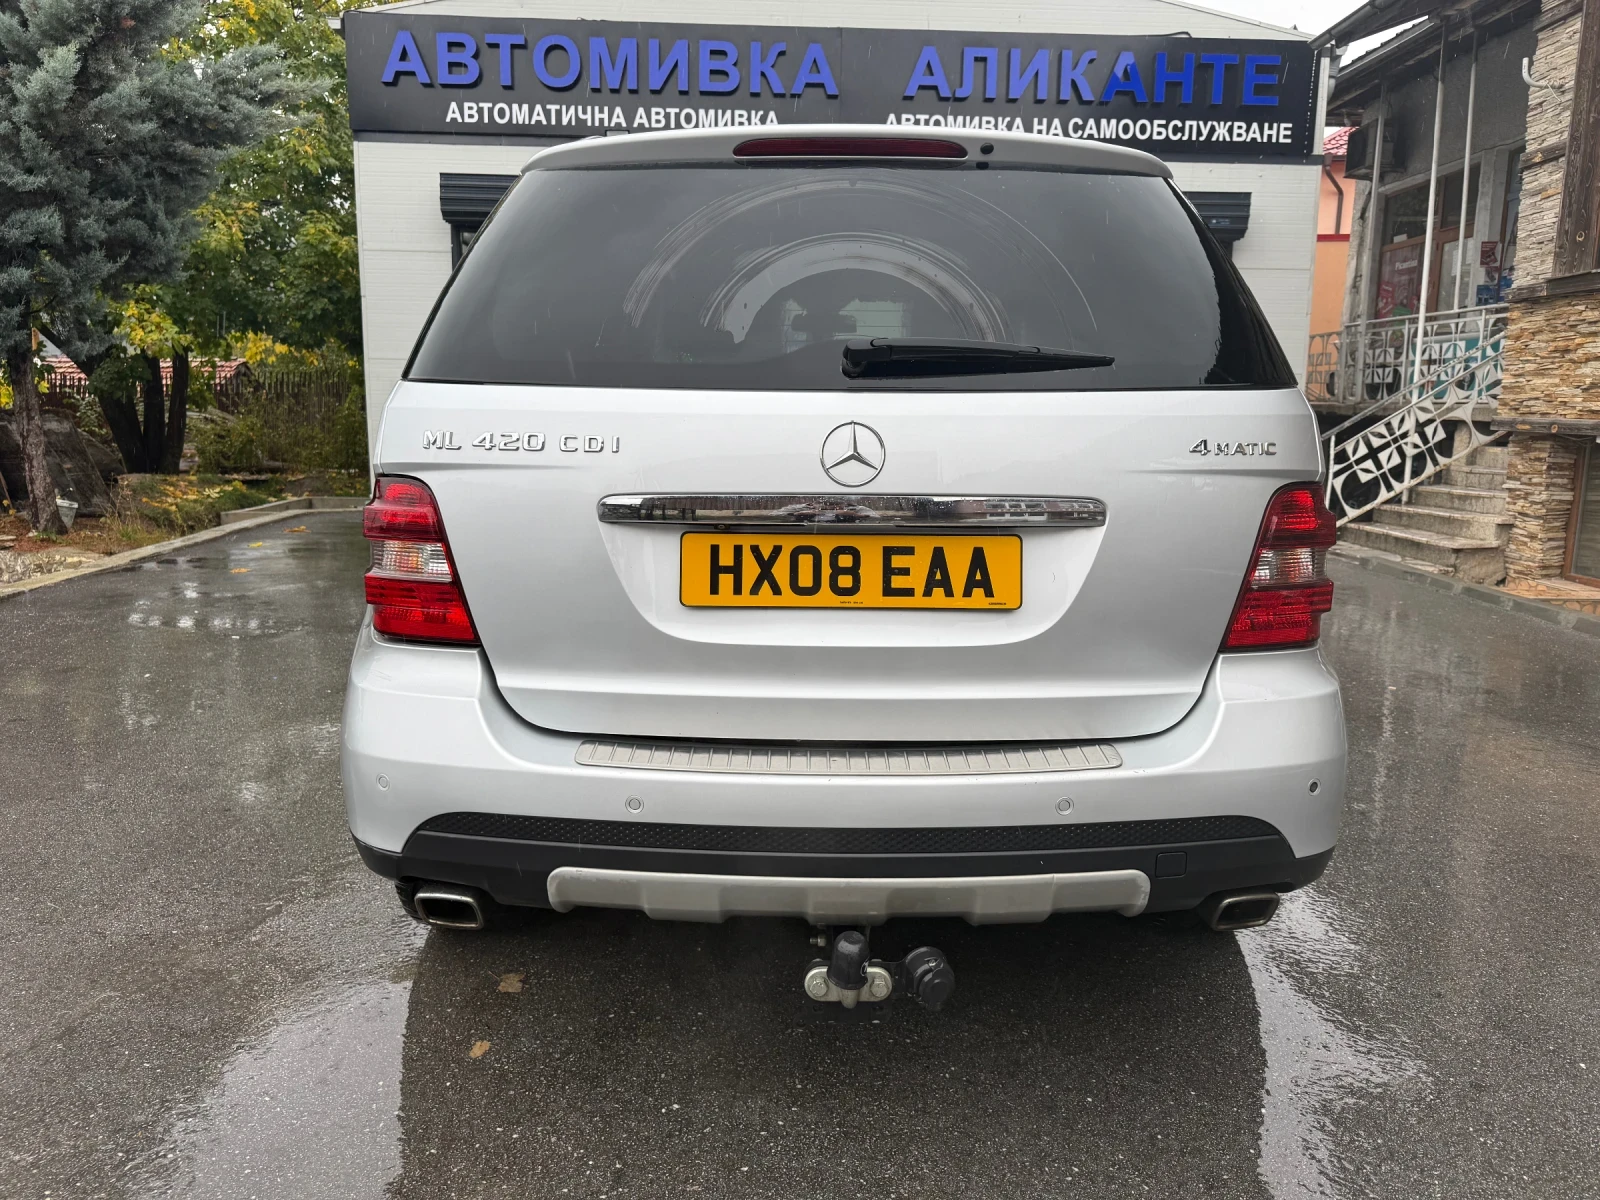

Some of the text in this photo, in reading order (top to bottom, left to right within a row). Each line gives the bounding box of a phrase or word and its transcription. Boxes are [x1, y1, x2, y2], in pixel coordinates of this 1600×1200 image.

[380, 29, 1282, 106] АВТОМИВКА АЛИКАНТЕ
[445, 101, 779, 129] АВТОМАТИЧНА АВТОМИВКА
[1032, 117, 1064, 138] НА
[1068, 117, 1293, 143] САМООБСЛУЖВАНЕ
[422, 430, 620, 453] ML 420 CDI
[709, 543, 996, 598] HX08 EAA
